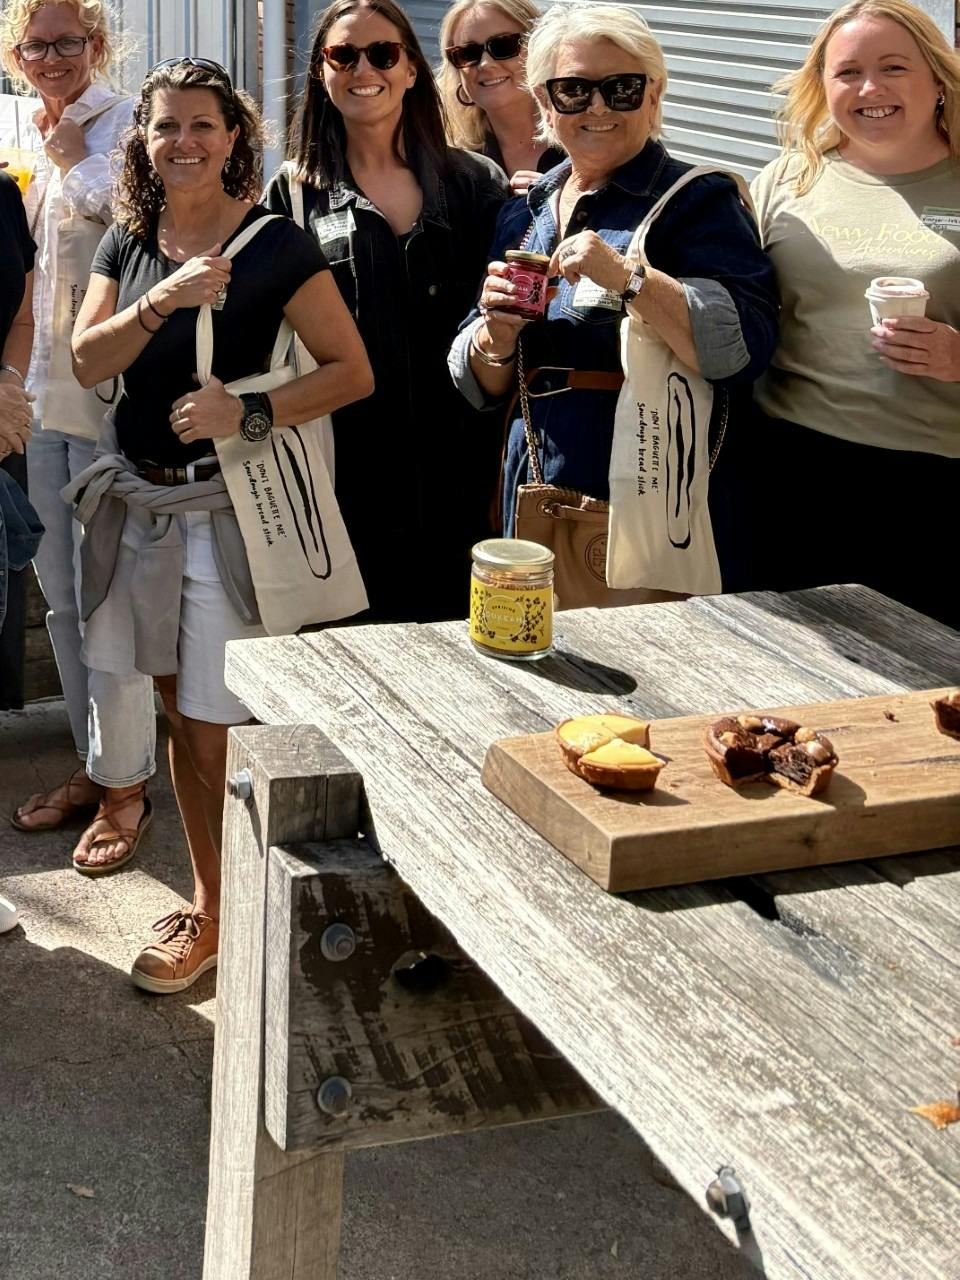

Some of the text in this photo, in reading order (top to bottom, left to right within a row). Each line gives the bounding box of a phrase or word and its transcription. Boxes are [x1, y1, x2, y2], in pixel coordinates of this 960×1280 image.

[636, 402, 648, 497] Sourdough bread stick
[652, 435, 660, 472] BAGUETTE
[242, 460, 274, 548] Sourdough bread stick
[264, 486, 280, 520] BAGUETTE
